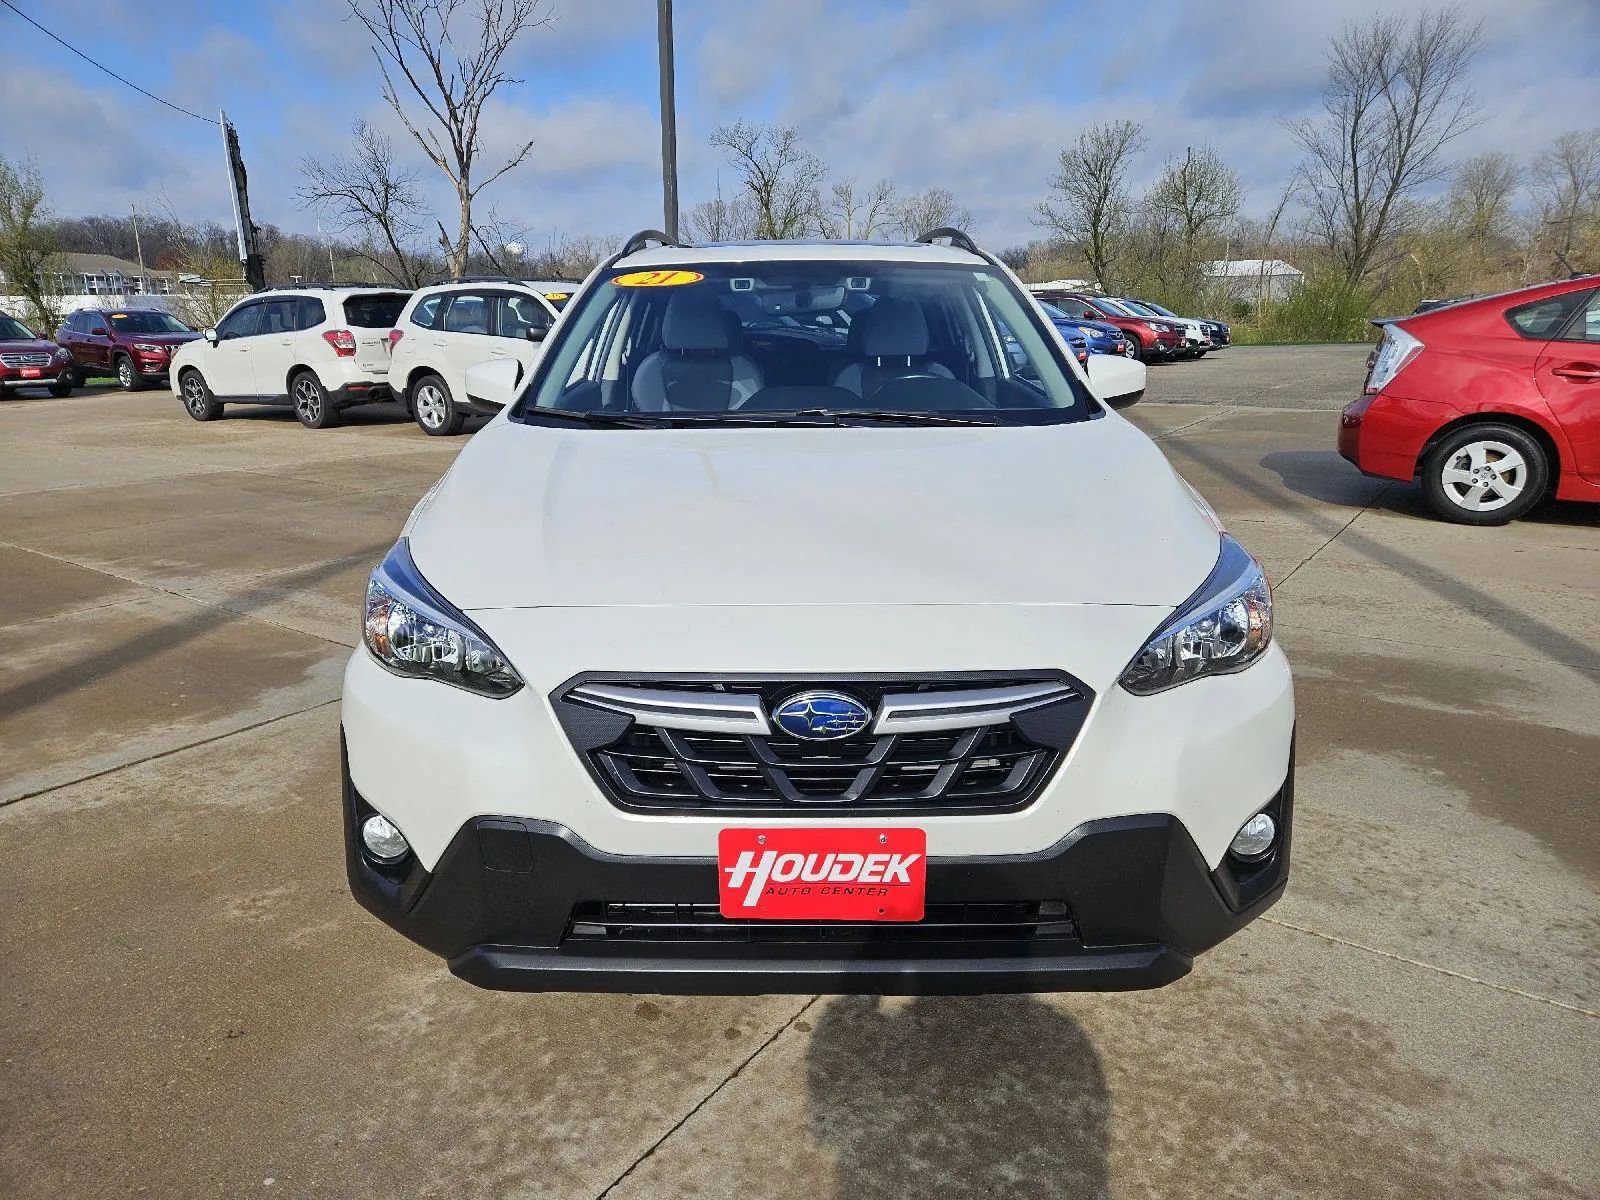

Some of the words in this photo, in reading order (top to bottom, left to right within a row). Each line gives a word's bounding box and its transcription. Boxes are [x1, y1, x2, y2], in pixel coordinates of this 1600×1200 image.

[634, 271, 678, 284] 21
[725, 851, 921, 907] HOUDEK
[766, 887, 812, 895] AUTO
[820, 887, 888, 896] CENTER
